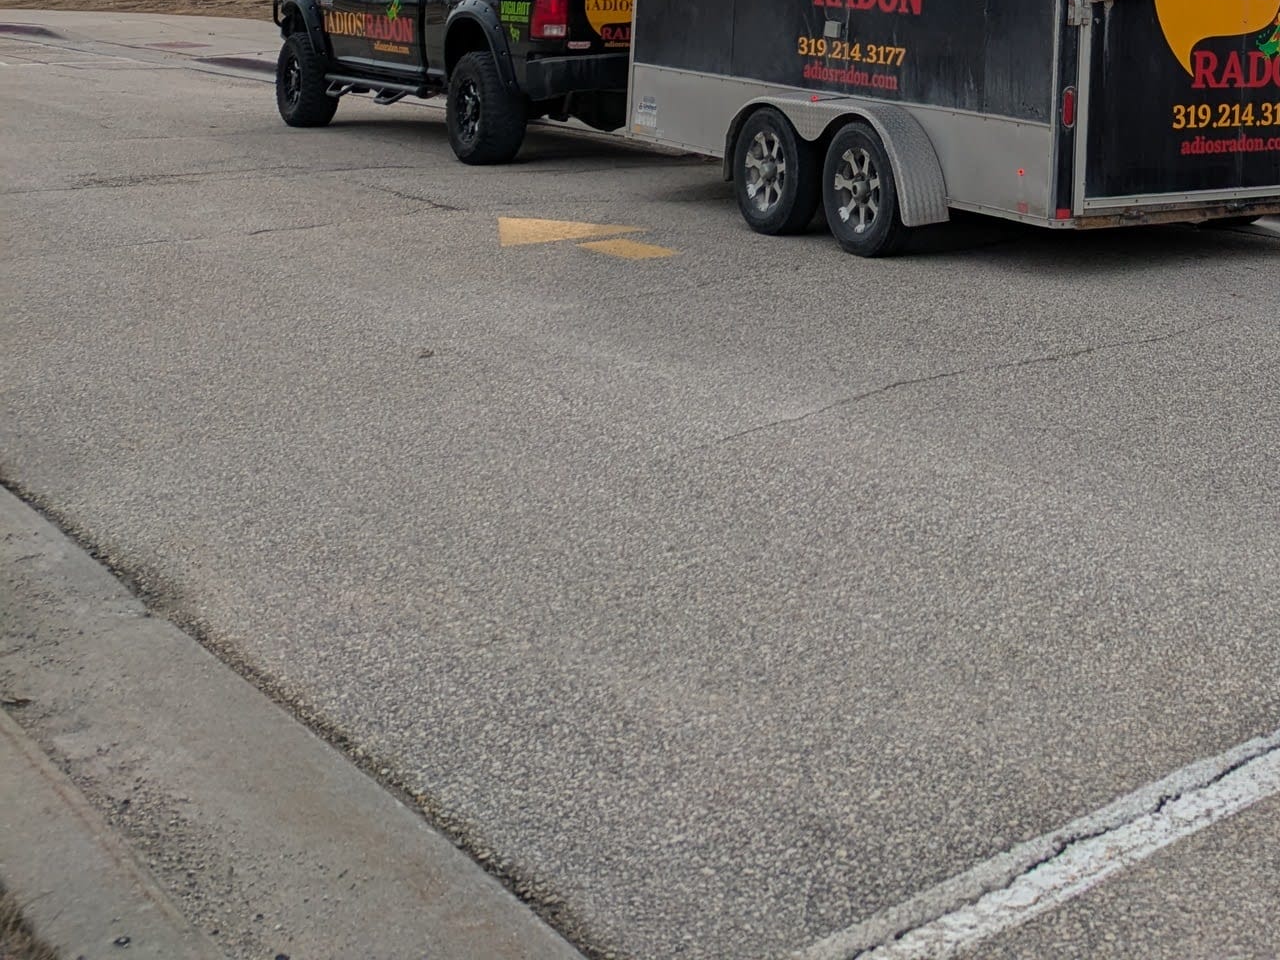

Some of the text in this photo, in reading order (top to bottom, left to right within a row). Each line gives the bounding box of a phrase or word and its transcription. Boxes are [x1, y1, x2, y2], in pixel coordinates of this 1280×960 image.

[323, 9, 414, 43] ¡ADIOS! RADON
[797, 36, 906, 67] 319.214.3177
[803, 61, 898, 90] adiosradon.com
